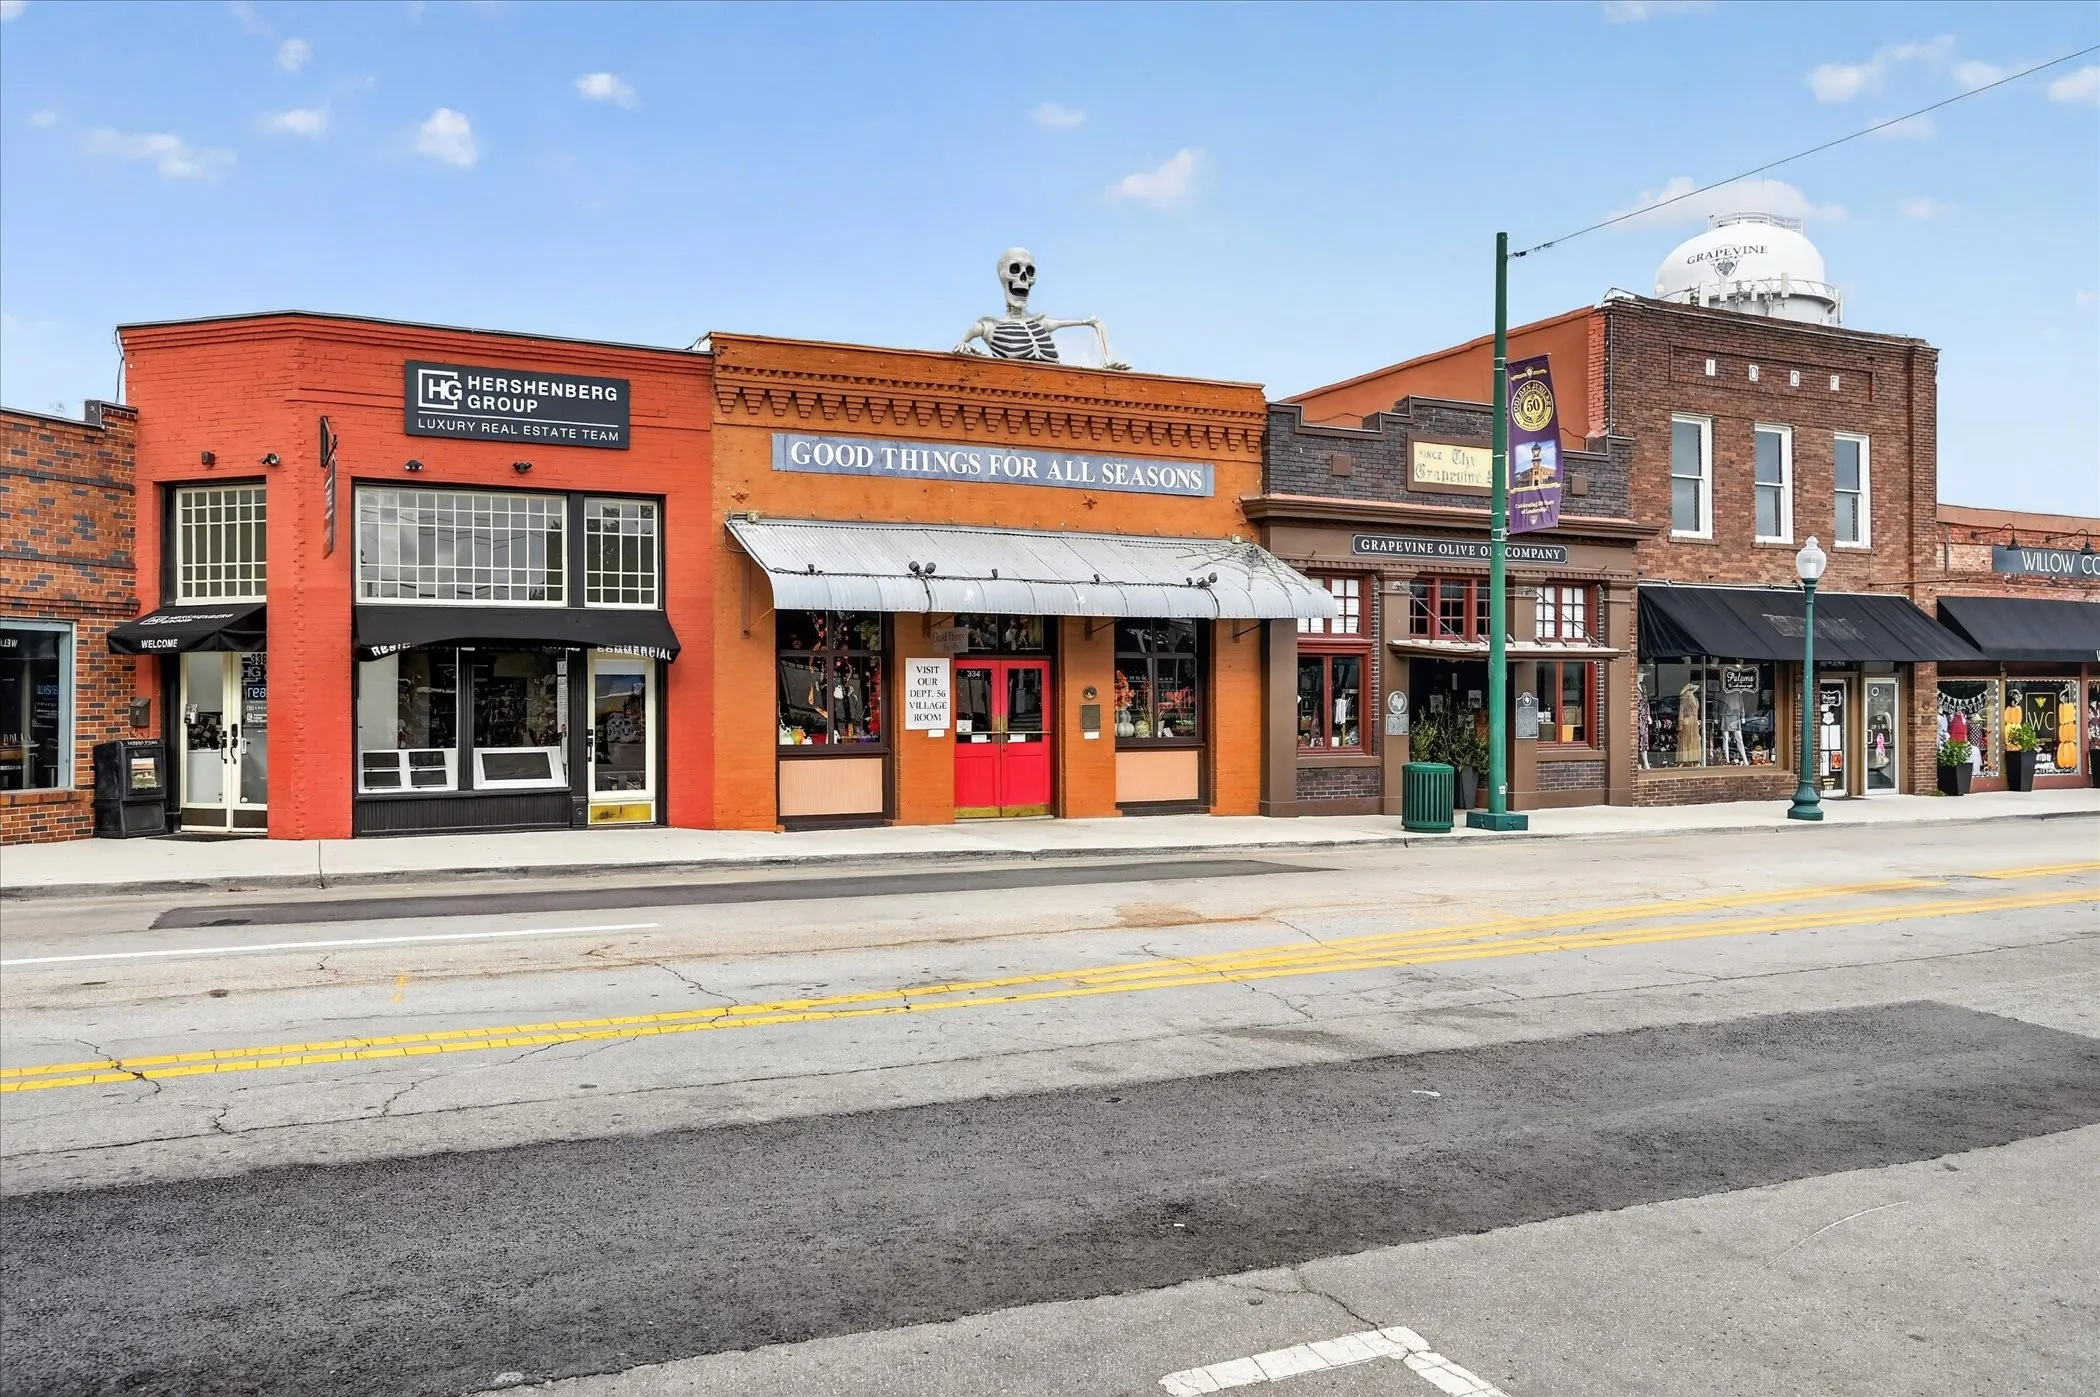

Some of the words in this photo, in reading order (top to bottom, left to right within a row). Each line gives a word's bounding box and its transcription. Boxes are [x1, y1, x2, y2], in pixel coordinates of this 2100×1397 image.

[1687, 245, 1768, 265] GRAPEVINE
[428, 378, 463, 401] HG
[467, 375, 618, 401] HERSHENBERG
[467, 395, 538, 413] GROUP
[1527, 398, 1540, 412] 50
[418, 418, 476, 432] LUXURY
[481, 423, 517, 435] REAL
[523, 425, 577, 440] ESTATE
[582, 429, 619, 442] TEAM
[1419, 450, 1443, 460] SINCE
[790, 441, 874, 468] GOOD
[880, 447, 981, 475] THINGS
[989, 454, 1038, 479] FOR
[1046, 459, 1096, 483] ALL
[1102, 462, 1203, 490] SEASONS
[1361, 539, 1434, 554] GRAPEVINE
[1438, 543, 1476, 557] OLIVE
[1480, 545, 1492, 557] OI
[1505, 546, 1561, 560] COMPANY
[2021, 551, 2075, 573] WILLOW
[141, 638, 178, 649] WELCOME
[916, 665, 940, 674] VISIT
[967, 670, 981, 678] 334
[917, 677, 938, 686] OUR
[909, 689, 934, 698] DEPT.
[936, 689, 946, 698] 56
[909, 701, 947, 710] VILLAGE
[914, 713, 942, 722] ROOM
[2028, 711, 2054, 731] WC
